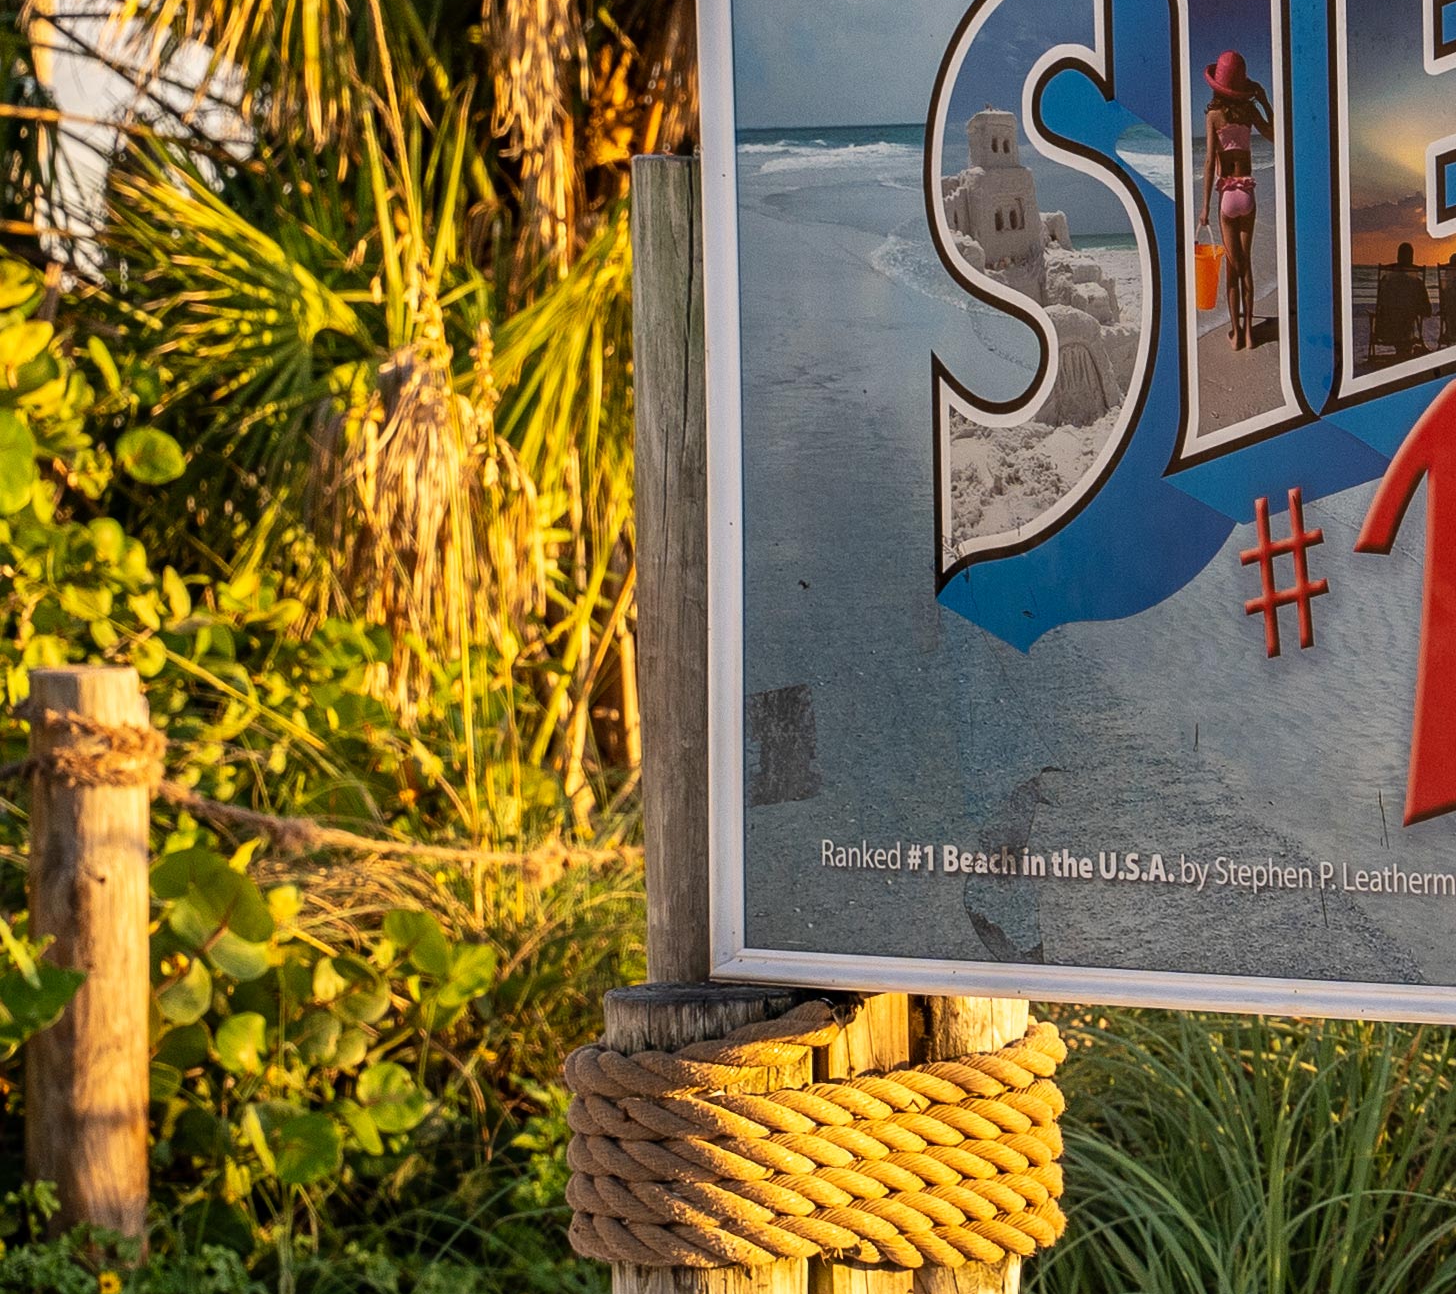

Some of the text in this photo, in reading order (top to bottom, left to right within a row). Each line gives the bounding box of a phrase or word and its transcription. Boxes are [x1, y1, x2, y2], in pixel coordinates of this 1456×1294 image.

[821, 839, 901, 870] Ranked
[907, 843, 935, 872] #1
[943, 844, 1017, 875] Beach
[1022, 847, 1047, 877] in
[1052, 848, 1094, 879] the
[1099, 851, 1176, 883] U.S.A.
[1180, 854, 1210, 892] by
[1215, 856, 1313, 894] Stephen
[1319, 861, 1337, 890] P.
